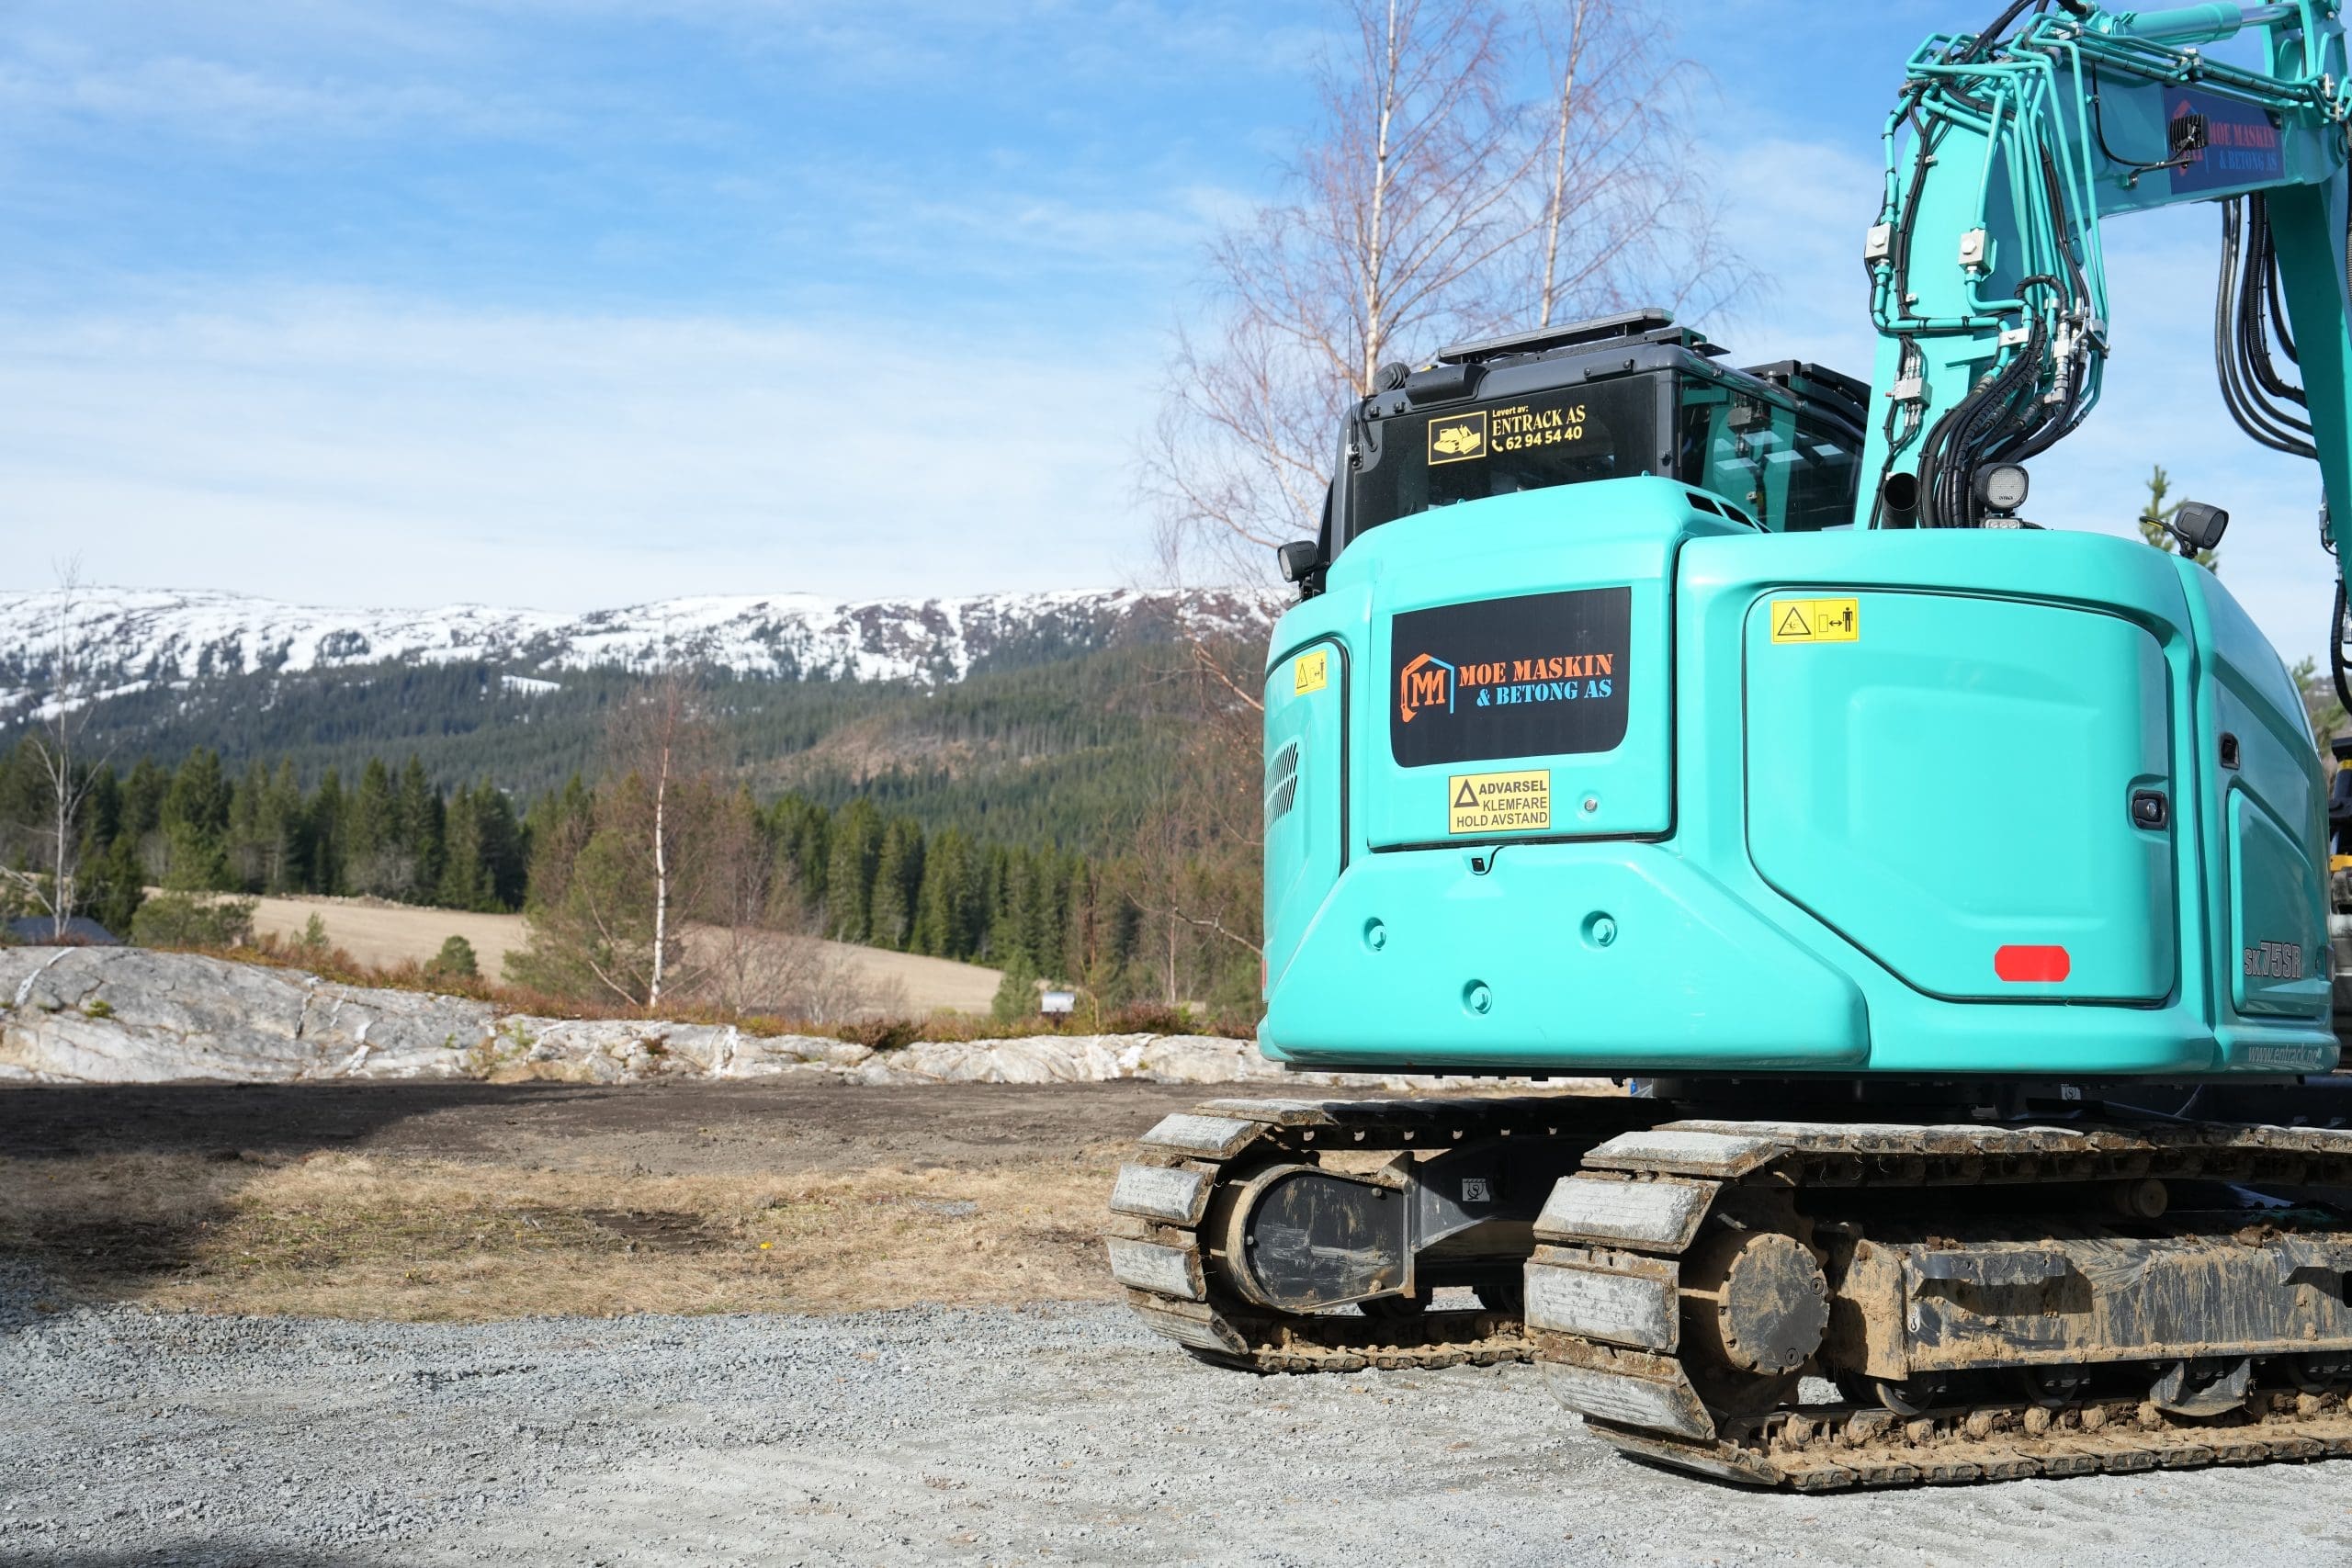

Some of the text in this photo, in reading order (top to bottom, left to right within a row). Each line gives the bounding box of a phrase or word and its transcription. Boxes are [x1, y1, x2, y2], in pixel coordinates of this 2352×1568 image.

[2233, 124, 2276, 147] MASKIN
[2228, 150, 2265, 171] BETONG
[1517, 405, 1529, 413] av:
[1492, 405, 1586, 436] ENTRACK AS
[1506, 425, 1583, 450] 62 94 54 40
[1459, 653, 1613, 687] MOE MASKIN
[1476, 679, 1612, 707] & BETONG AS
[1478, 779, 1547, 795] ADVARSEL
[1483, 796, 1547, 812] KLEMFARE
[1456, 811, 1548, 828] HOLD AVSTAND
